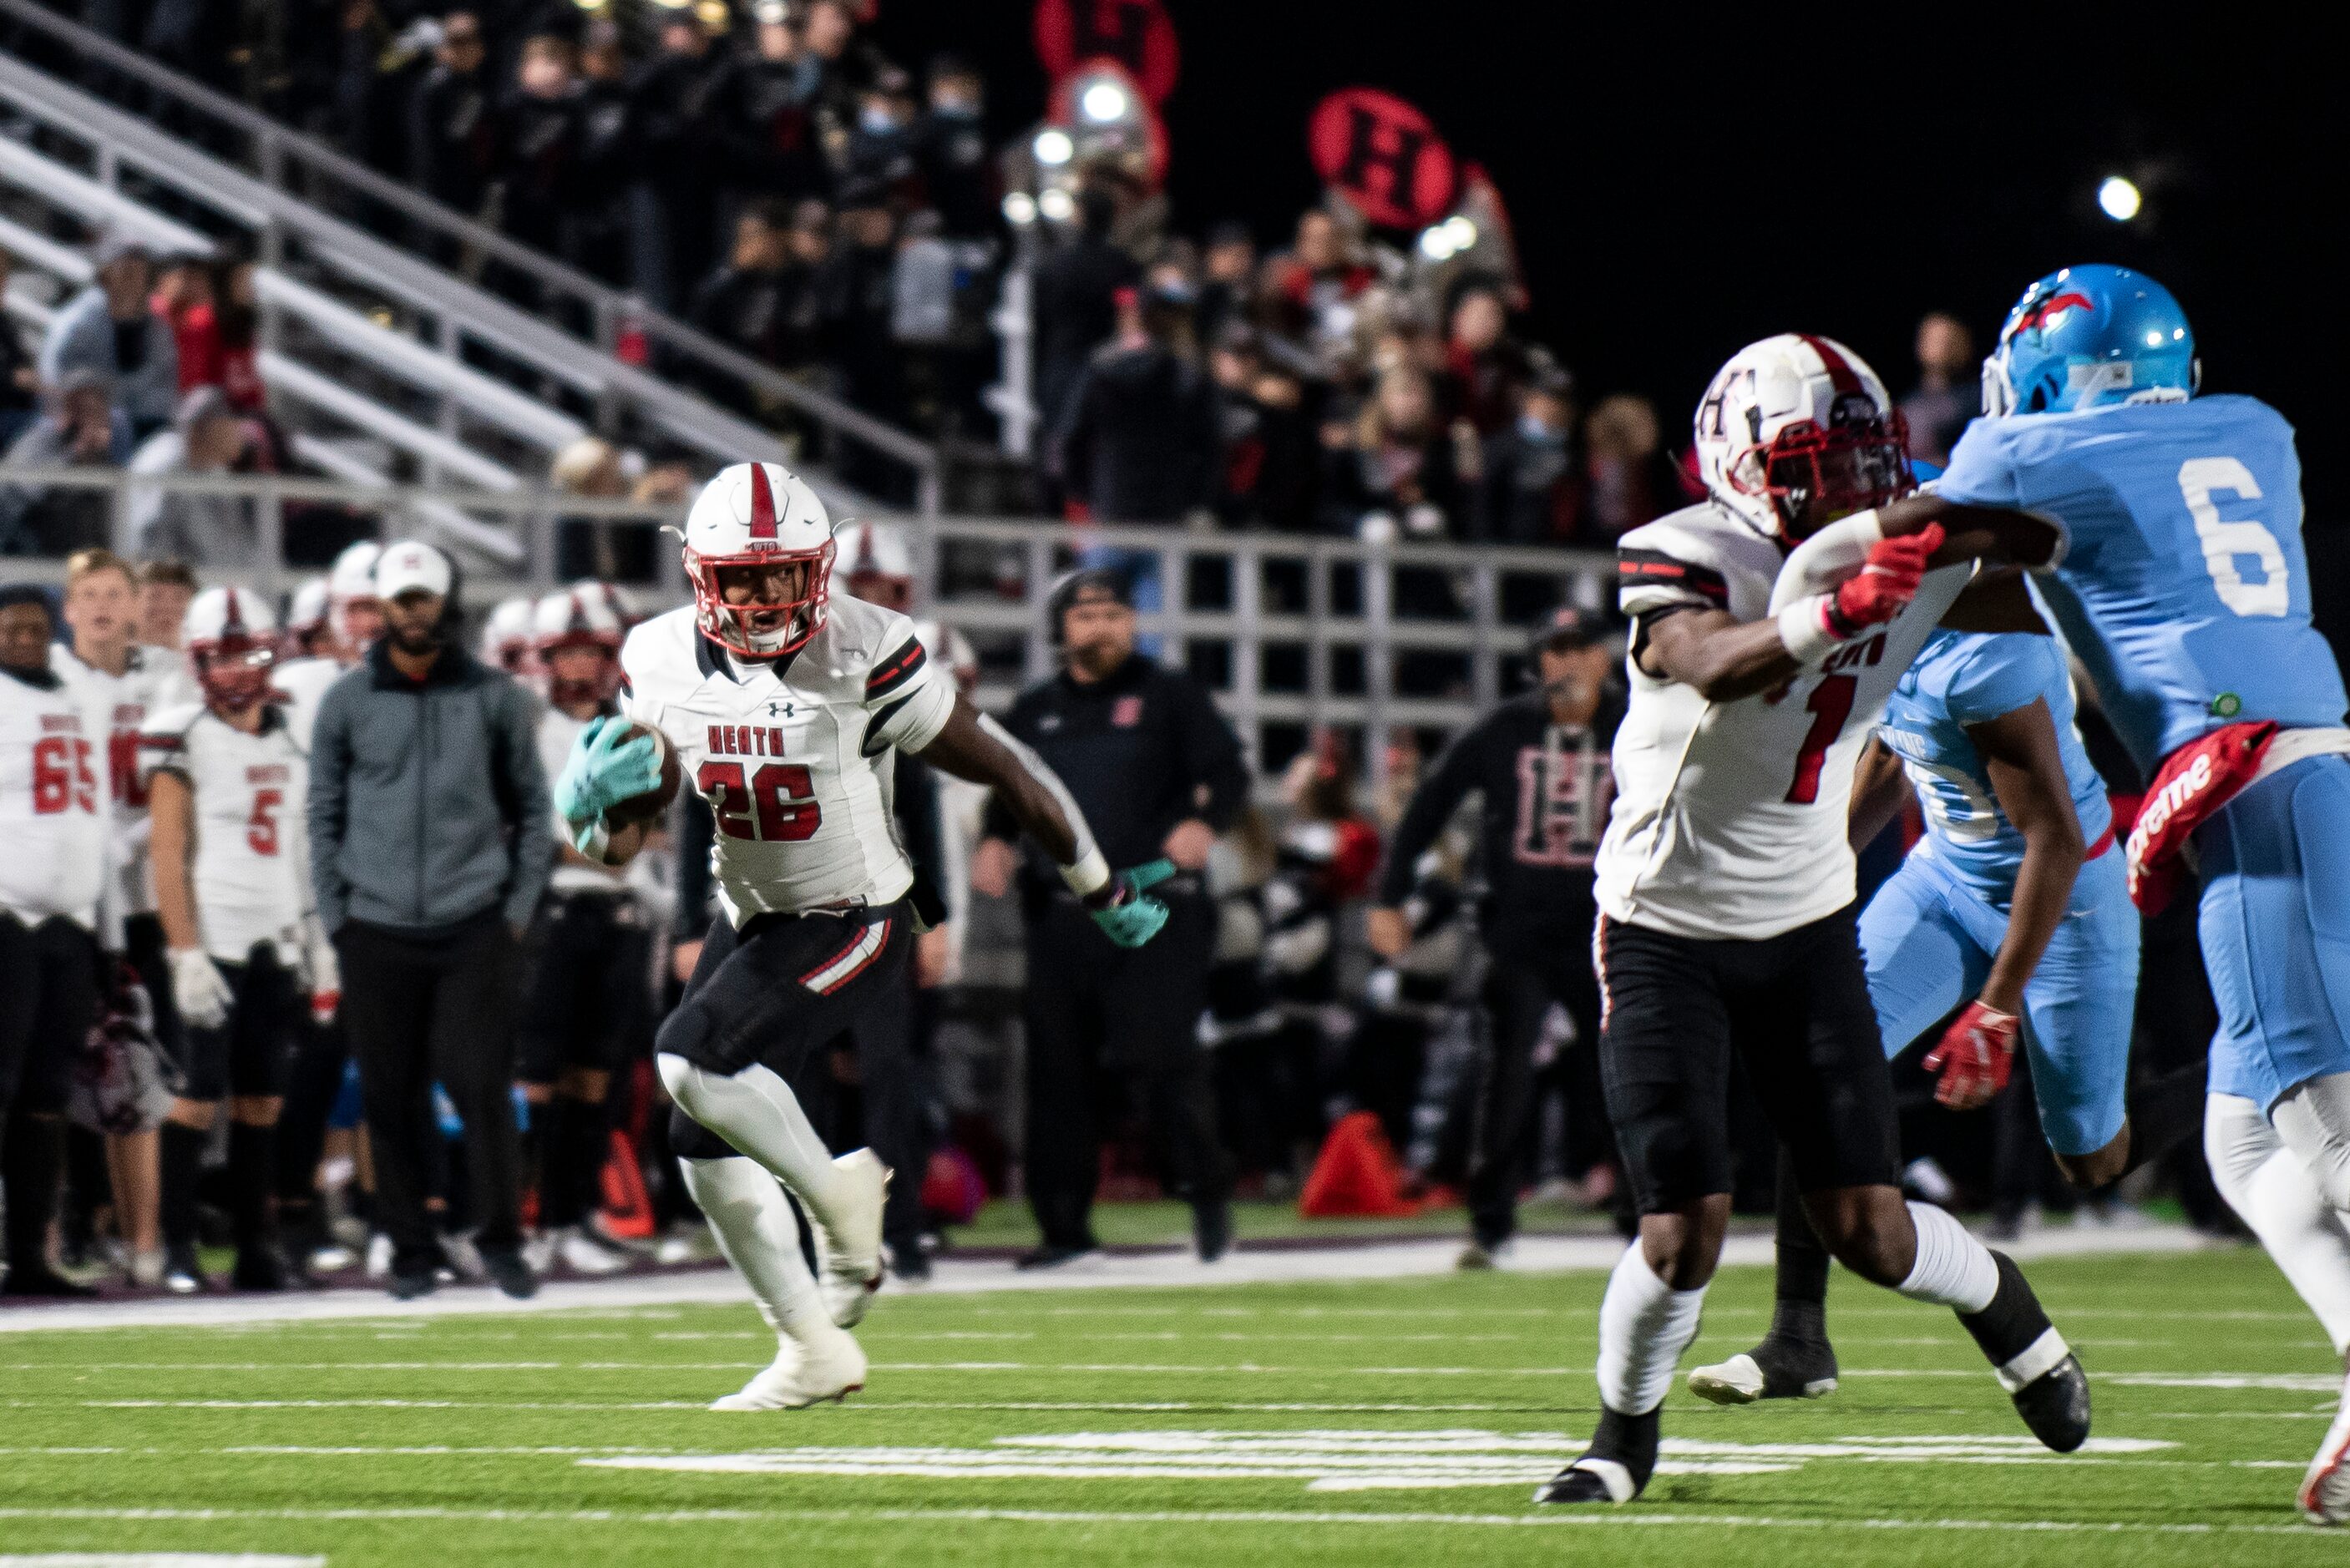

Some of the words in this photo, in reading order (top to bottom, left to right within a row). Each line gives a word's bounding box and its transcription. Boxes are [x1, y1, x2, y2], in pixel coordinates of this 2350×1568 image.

[1341, 105, 1428, 212] H
[2178, 456, 2289, 618] 6
[707, 725, 785, 756] HEATH
[1784, 674, 1859, 804] 1
[246, 789, 283, 857] 5
[697, 761, 823, 842] 26
[1513, 745, 1613, 866] H
[2125, 753, 2212, 895] preme
